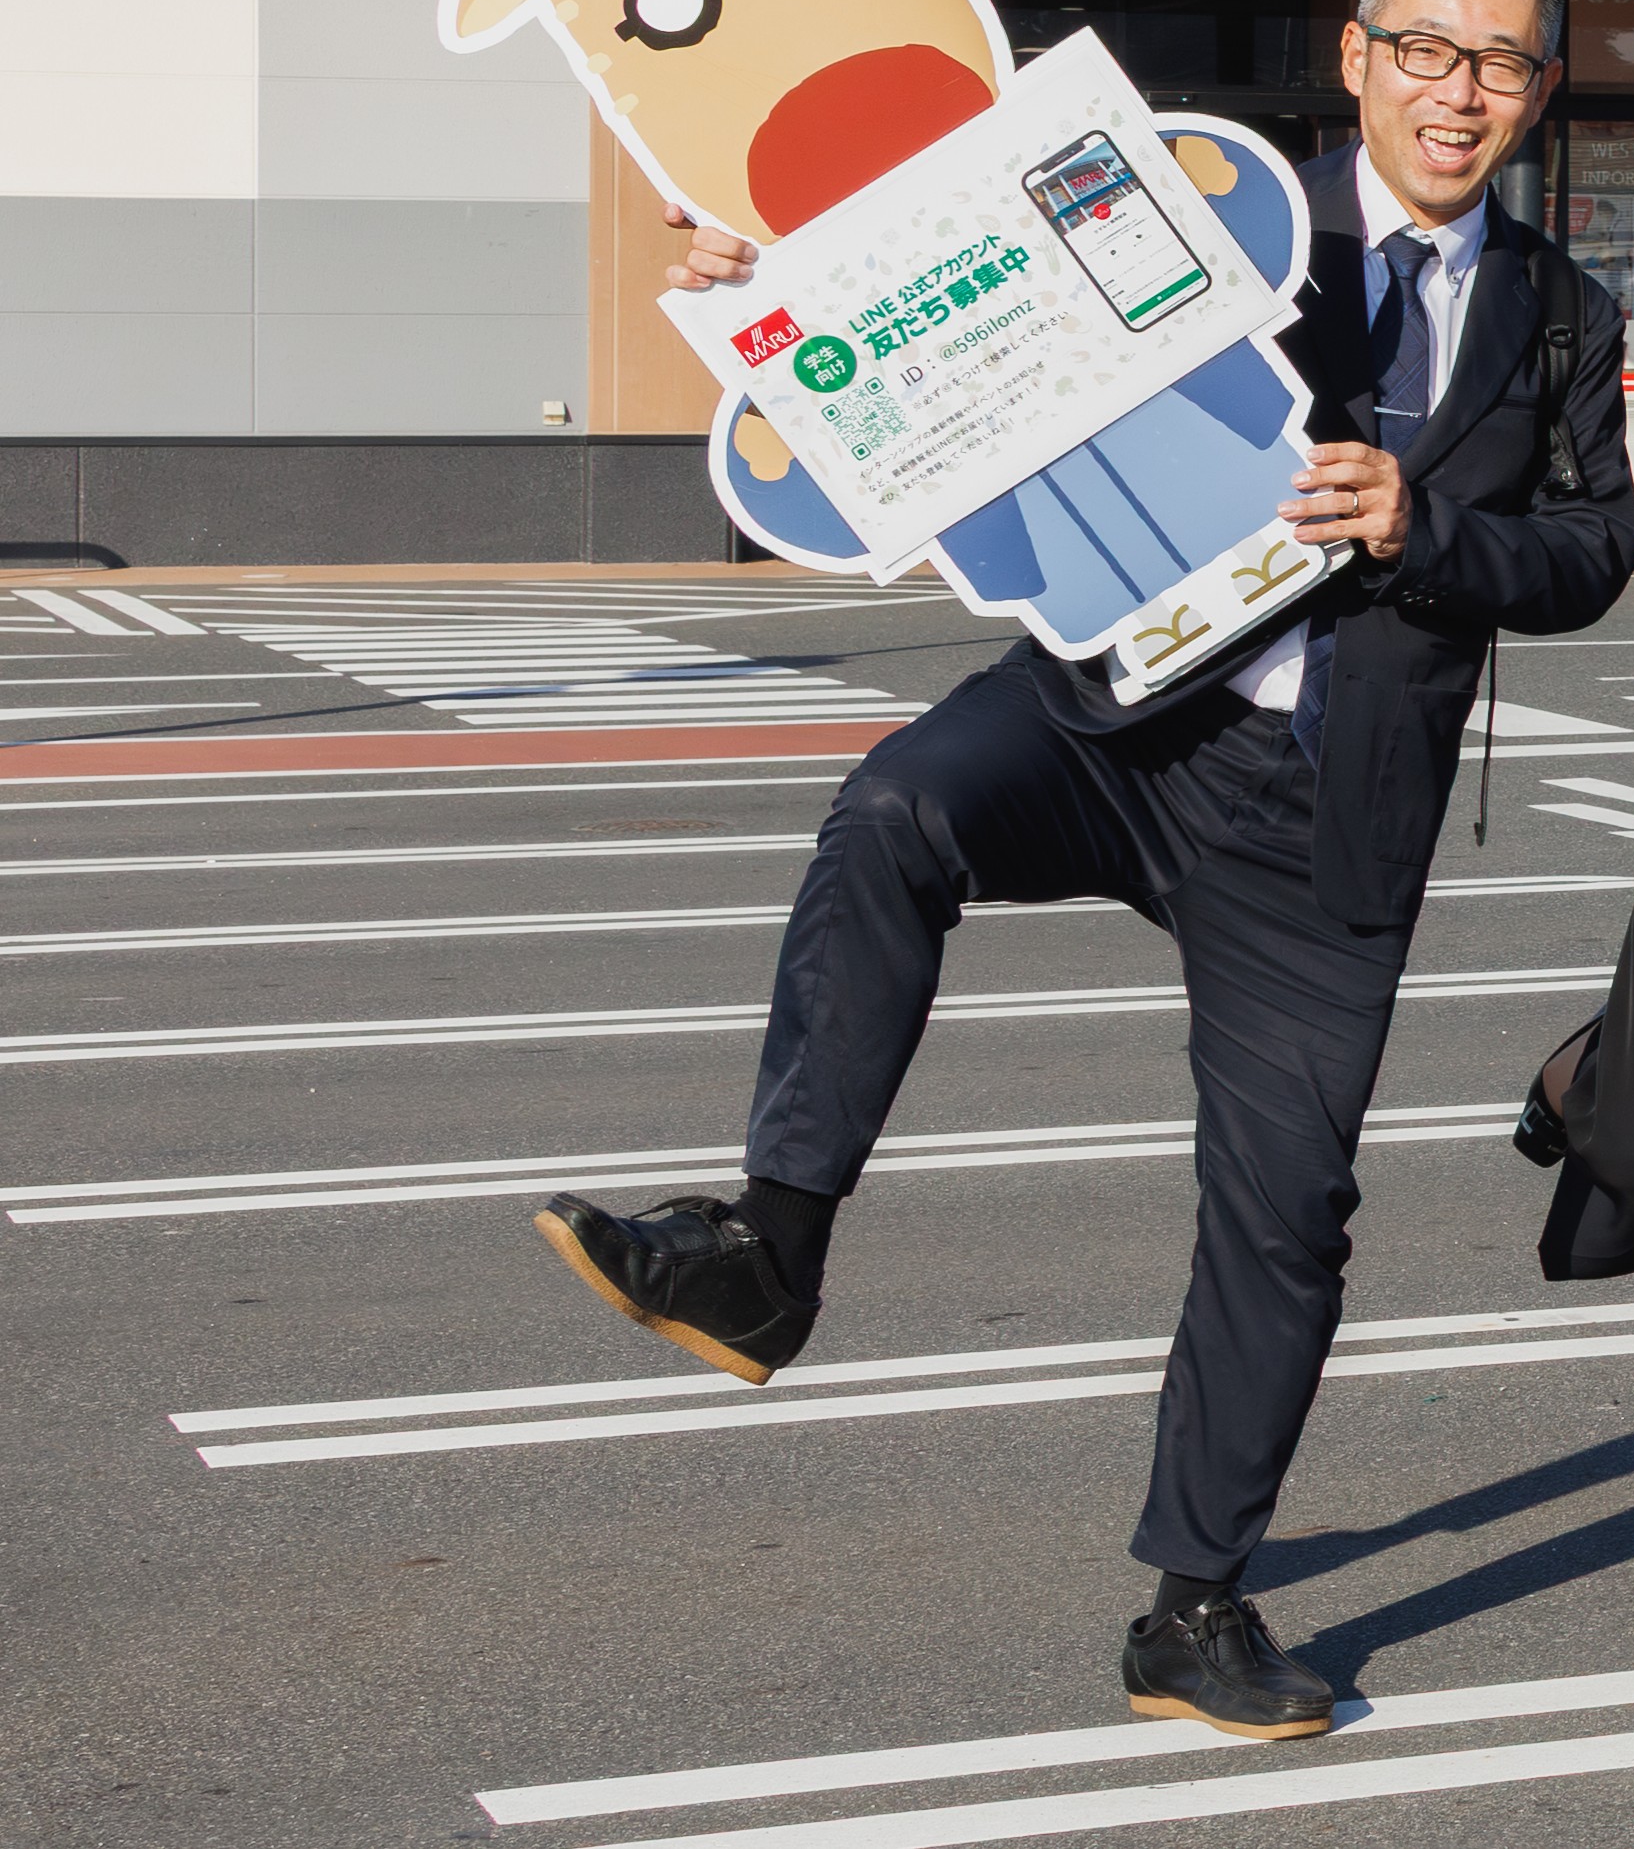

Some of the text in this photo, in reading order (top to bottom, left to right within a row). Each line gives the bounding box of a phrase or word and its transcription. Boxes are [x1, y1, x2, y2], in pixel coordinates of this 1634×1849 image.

[848, 232, 1002, 335] LINE 公式アカウント
[862, 245, 1031, 361] 友だち募集中
[744, 323, 800, 364] MARUI
[803, 346, 838, 371] 学生
[814, 358, 847, 387] 向け
